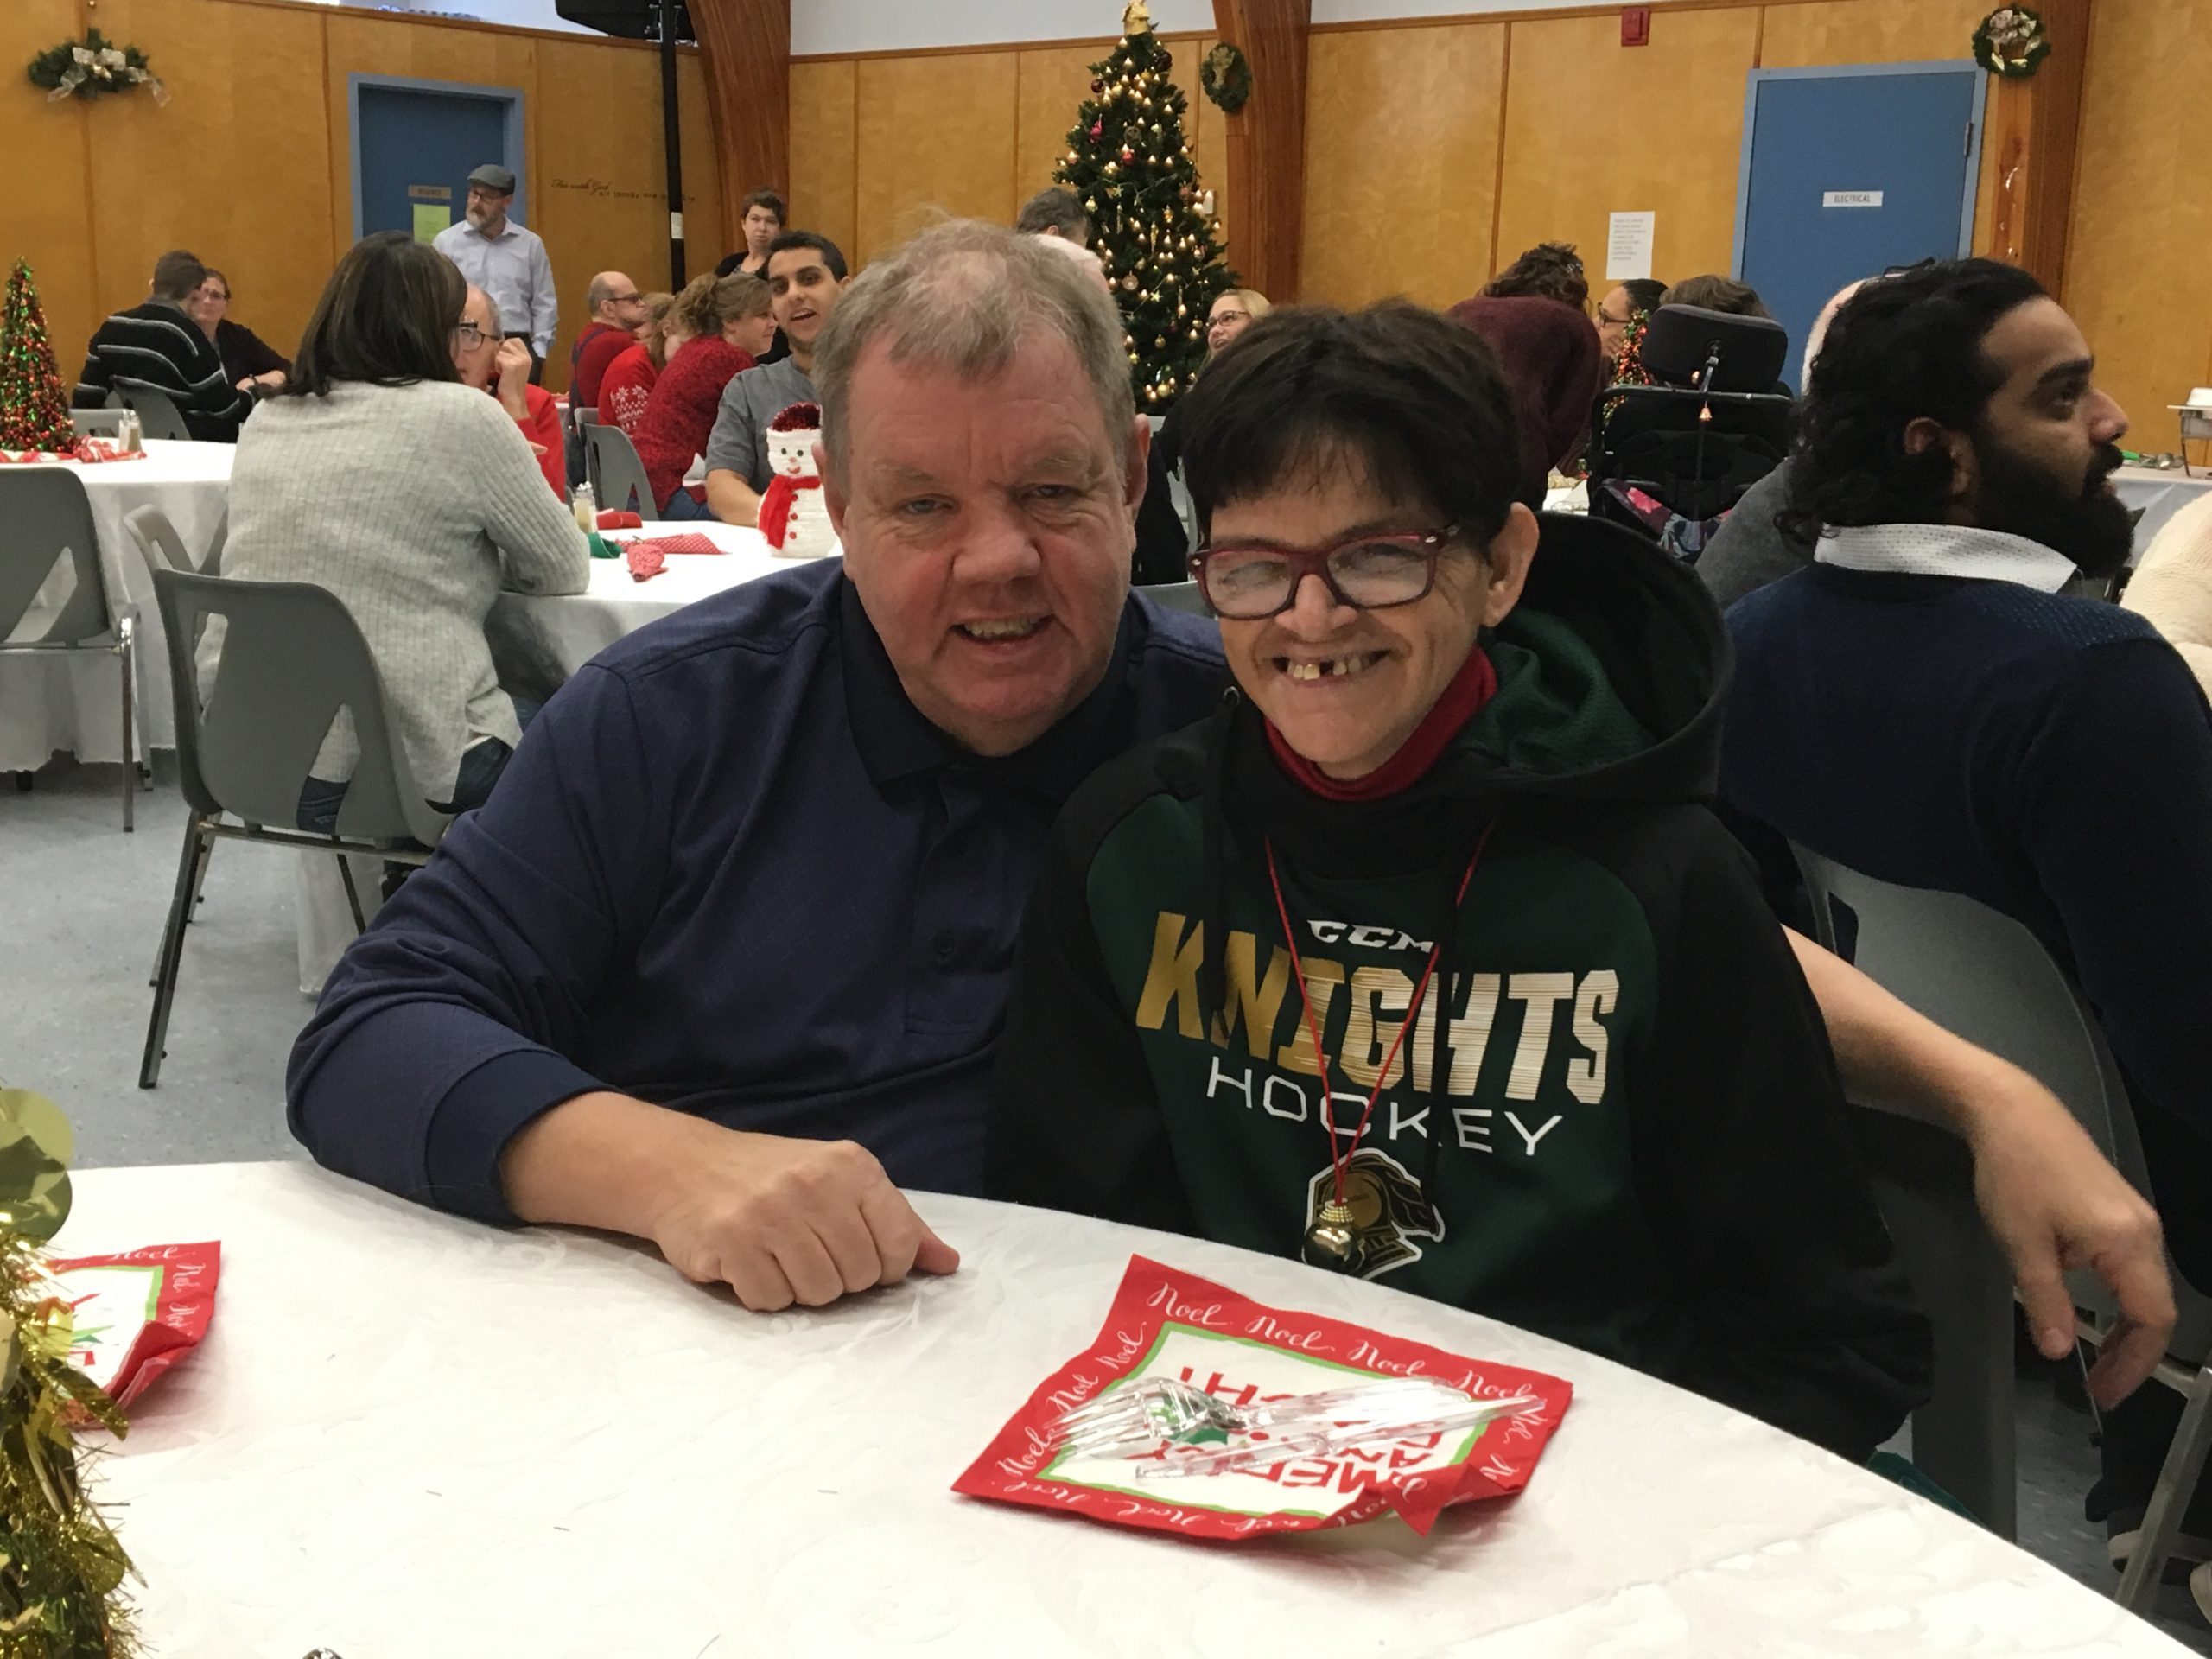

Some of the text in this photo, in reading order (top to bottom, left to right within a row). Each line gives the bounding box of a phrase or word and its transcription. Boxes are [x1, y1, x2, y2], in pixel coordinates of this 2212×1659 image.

[1834, 194, 1872, 204] ELECTRICAL
[1306, 919, 1433, 954] CCM
[1135, 911, 1619, 1104] KNIGHTS
[1206, 1056, 1563, 1156] HOCKEY
[1147, 1281, 1234, 1325] Noel
[1244, 1315, 1336, 1351] Noel
[1346, 1340, 1427, 1377] Noel
[995, 1426, 1058, 1476] Noel
[1094, 1321, 1147, 1370] Noel
[1103, 1497, 1207, 1527] Noel
